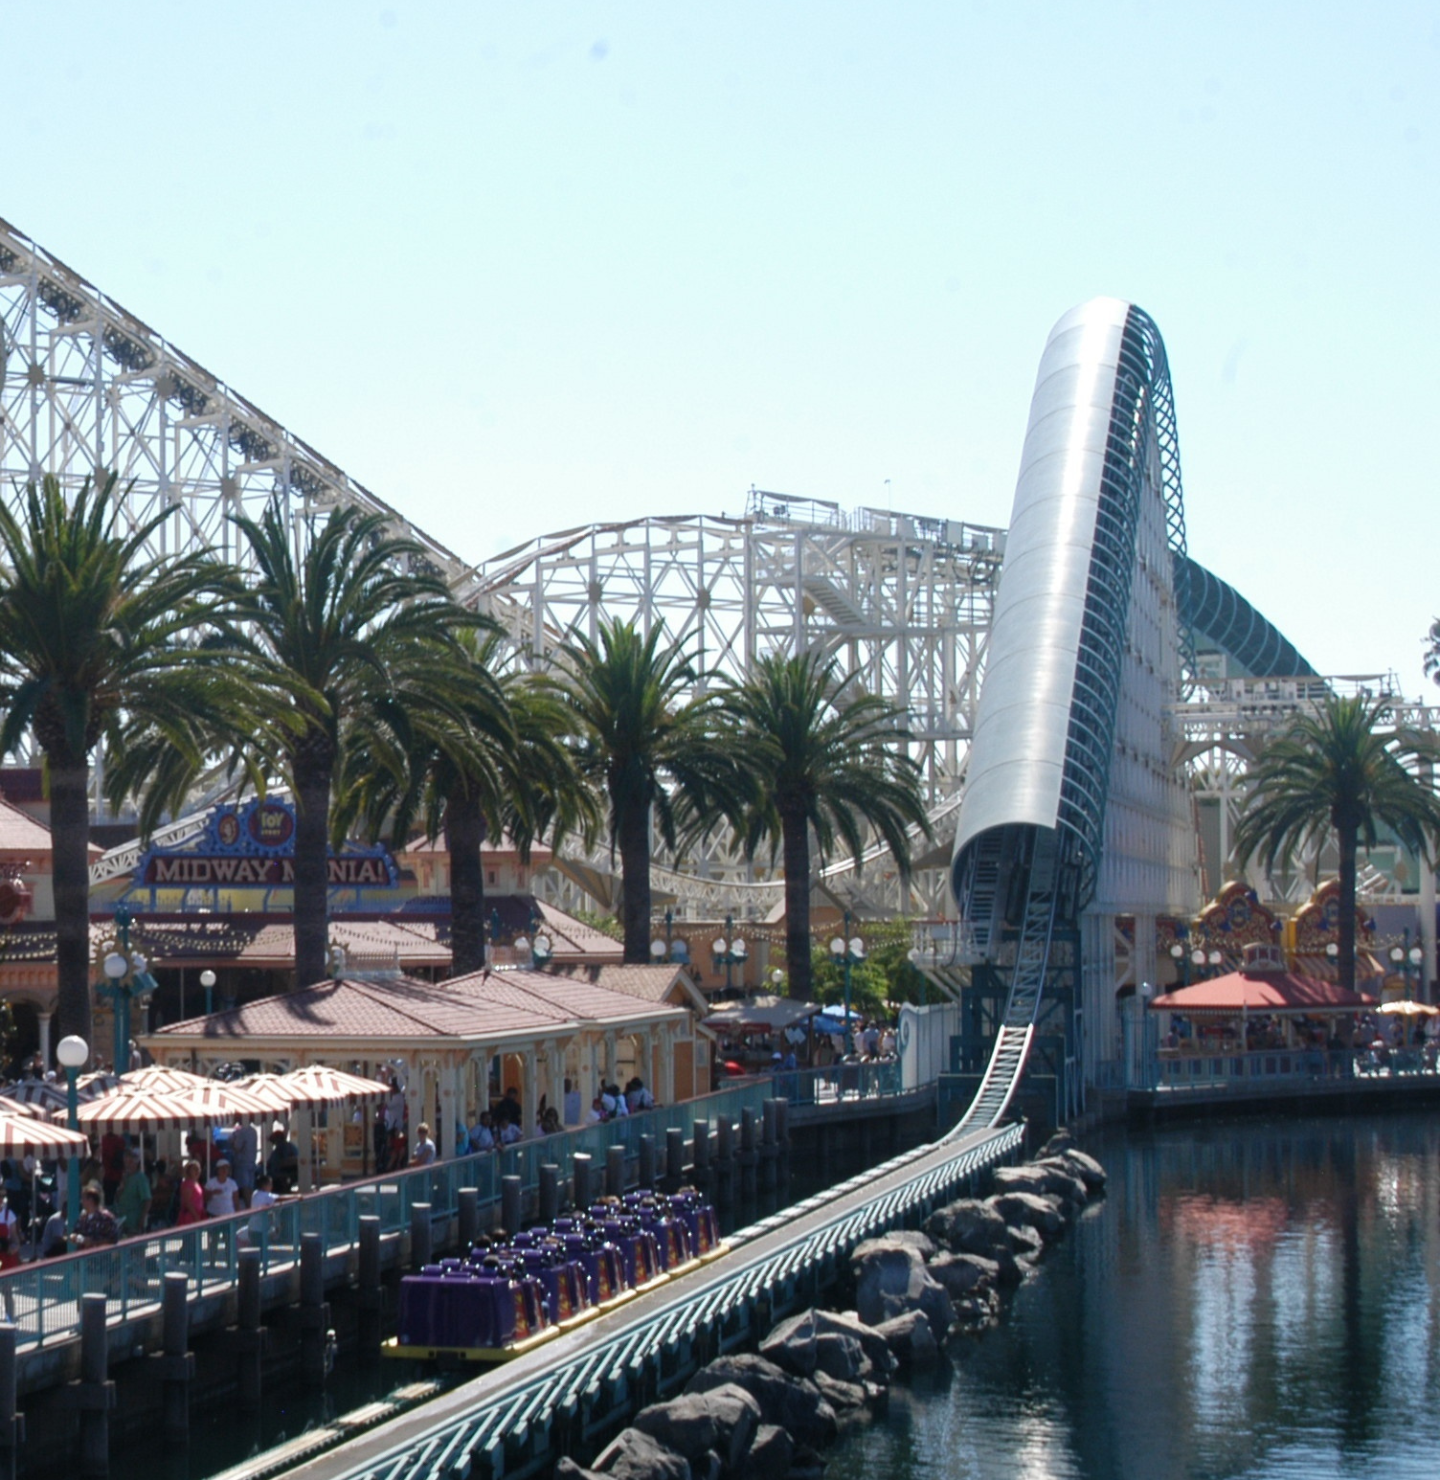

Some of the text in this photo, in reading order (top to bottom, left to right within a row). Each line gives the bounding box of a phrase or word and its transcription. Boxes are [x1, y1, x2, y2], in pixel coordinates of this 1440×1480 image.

[261, 811, 285, 828] TOY
[155, 859, 384, 882] MIDWAY MNIA!
